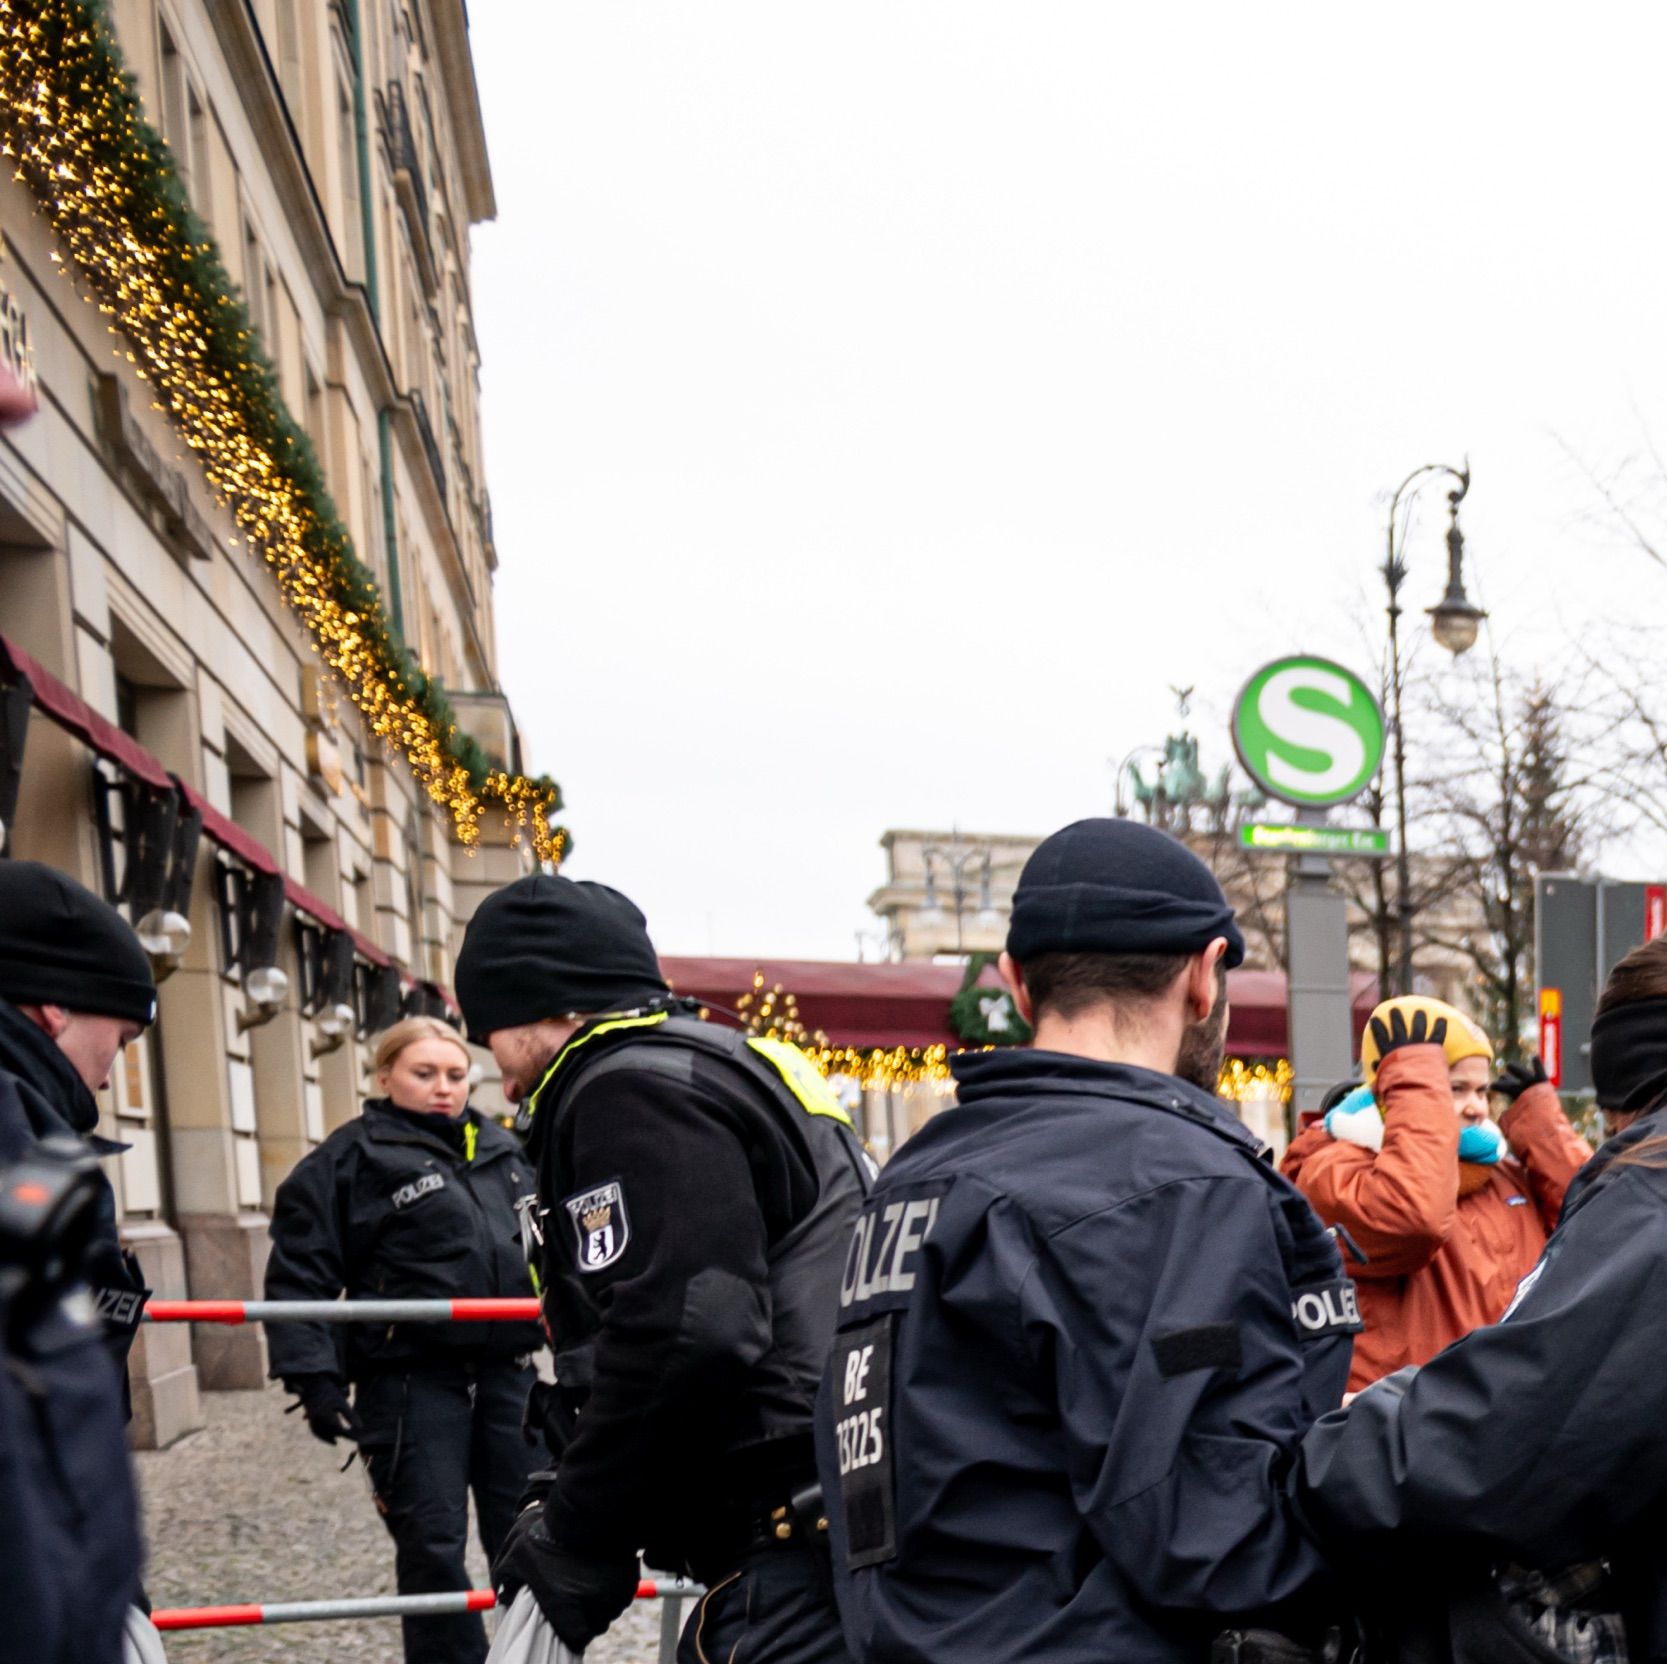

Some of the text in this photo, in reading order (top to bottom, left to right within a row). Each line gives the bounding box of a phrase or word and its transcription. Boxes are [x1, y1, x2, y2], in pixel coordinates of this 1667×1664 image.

[1258, 666, 1365, 794] S
[392, 1173, 445, 1210] POLIZEI
[844, 1344, 874, 1405] BE
